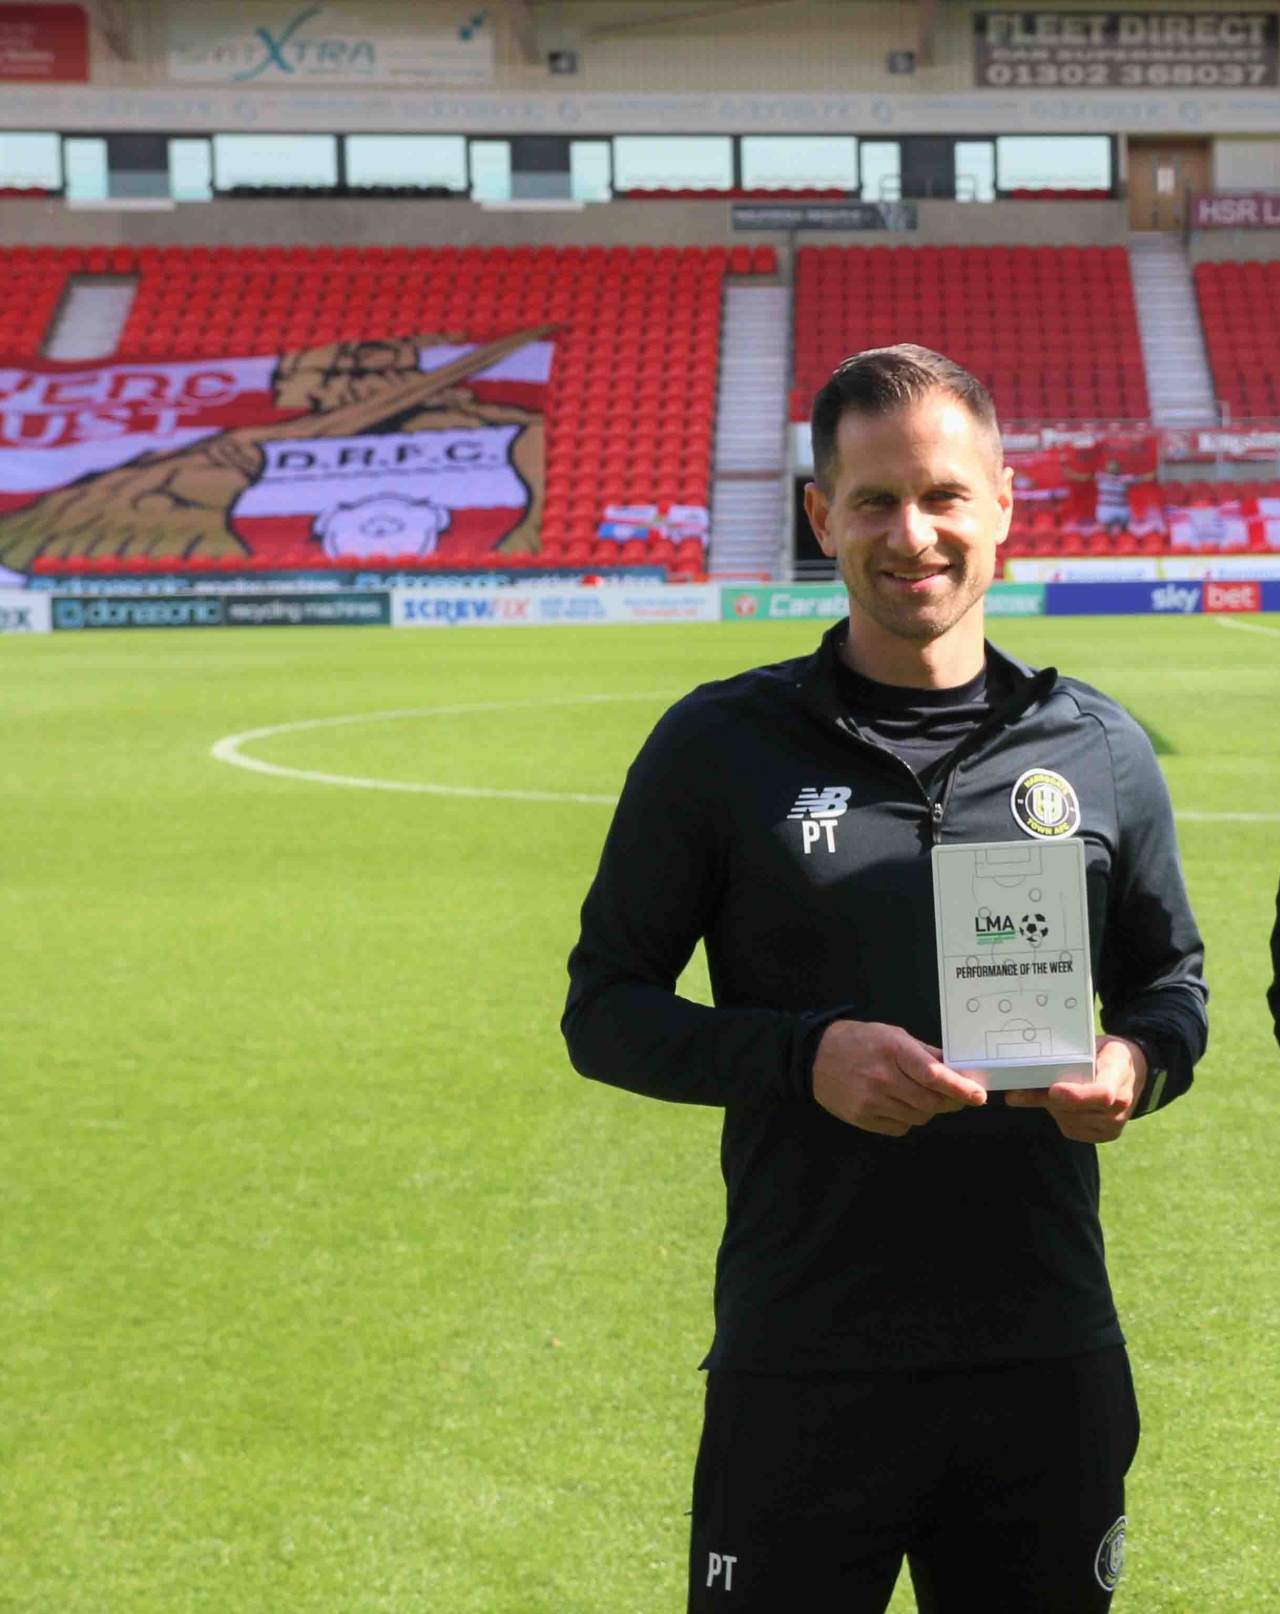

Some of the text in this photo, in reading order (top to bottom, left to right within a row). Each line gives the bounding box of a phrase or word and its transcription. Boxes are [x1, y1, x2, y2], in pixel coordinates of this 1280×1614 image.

[986, 15, 1267, 44] FLEET DIRECT
[986, 63, 1109, 86] 01302
[1199, 199, 1259, 223] HSR
[403, 598, 531, 622] SCREWFIX
[1151, 584, 1254, 613] sky bet
[801, 819, 839, 855] PT
[975, 915, 1015, 933] LMA
[956, 960, 1074, 979] PERFORMANCE OF THE WEEK
[705, 1551, 738, 1591] PT
